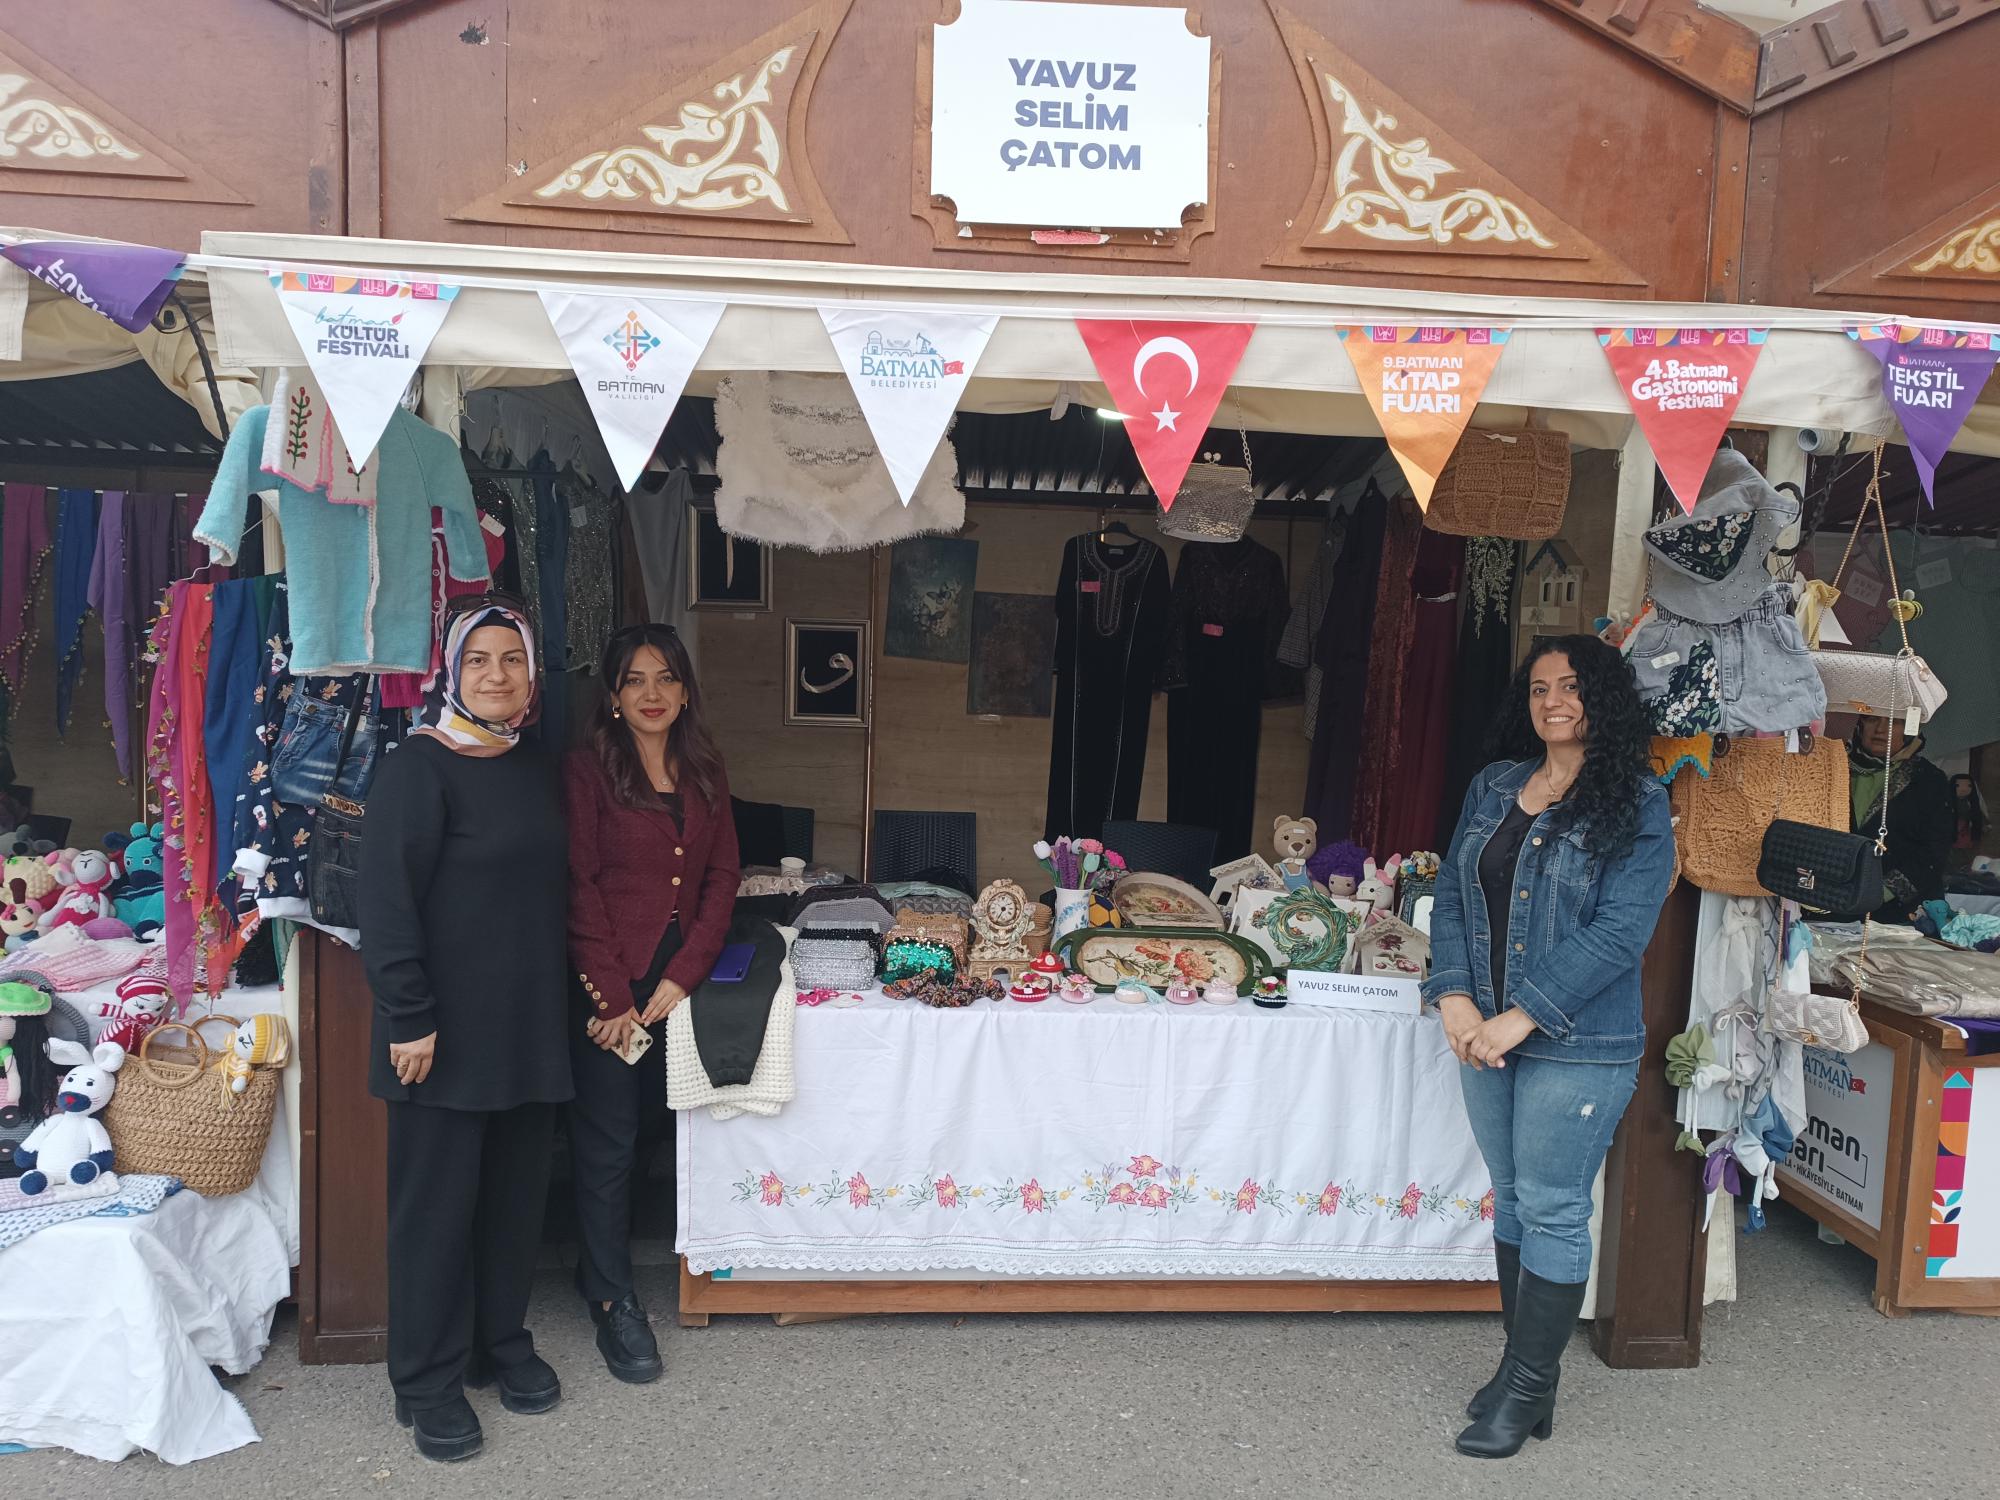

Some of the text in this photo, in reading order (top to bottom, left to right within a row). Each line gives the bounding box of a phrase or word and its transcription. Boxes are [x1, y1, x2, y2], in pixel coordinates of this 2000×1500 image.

[1008, 57, 1137, 91] YAVUZ
[1014, 93, 1129, 131] SELİM
[1000, 139, 1141, 171] ÇATOM
[328, 325, 399, 343] KÜLTÜR
[860, 356, 946, 378] BATMAN
[1888, 363, 1965, 390] TEKSTİL
[598, 381, 665, 394] BATMAN
[871, 379, 937, 389] BELEDİYESİ
[1631, 376, 1738, 400] Gastronomi
[1382, 393, 1461, 414] FUARI
[1894, 385, 1952, 409] FUARI
[1298, 980, 1398, 998] YAVUZ SELİM ÇATOM
[1803, 1055, 1853, 1092] ATMAN
[1804, 1113, 1860, 1162] man
[1789, 1138, 1825, 1173] arı
[1836, 1187, 1864, 1212] BATMAN
